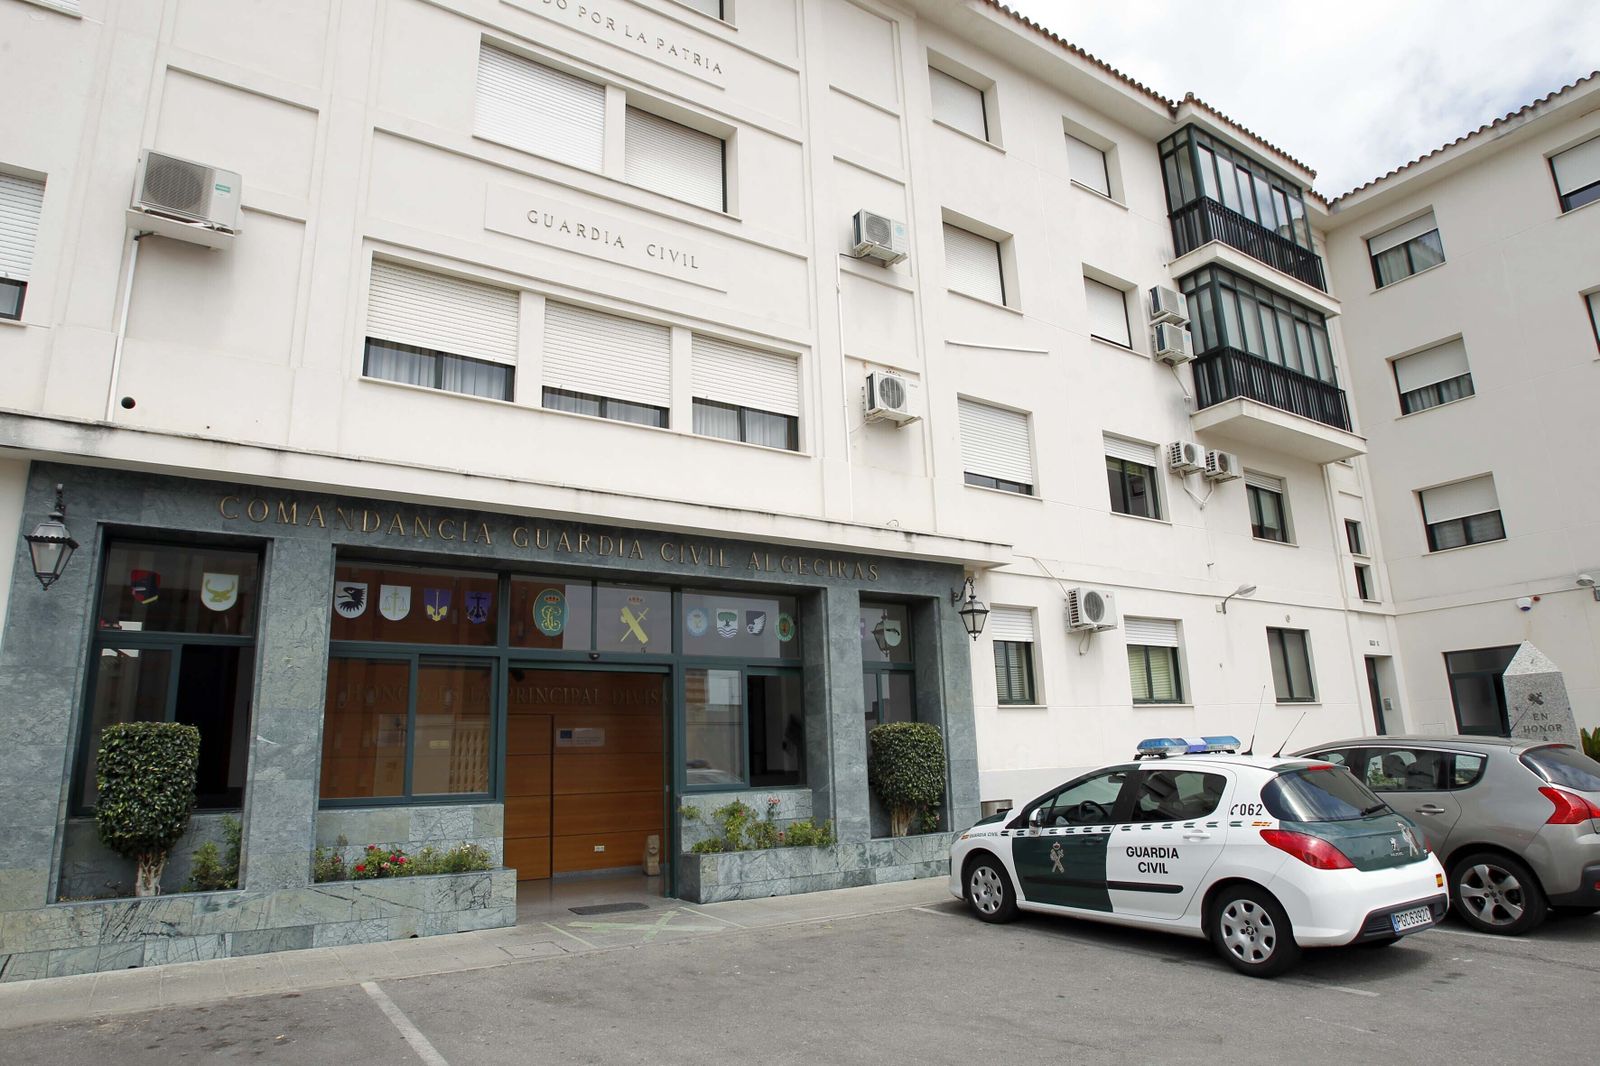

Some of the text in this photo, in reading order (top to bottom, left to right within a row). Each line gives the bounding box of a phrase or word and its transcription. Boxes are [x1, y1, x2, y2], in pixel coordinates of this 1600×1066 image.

[543, 0, 723, 75] O POR LA PATRIA
[526, 209, 699, 270] GUARDIA CIVIL
[219, 495, 880, 582] COMANDANCIA GUARDIA CIVIL ALGECIRAS
[1532, 712, 1549, 721] EN
[1522, 723, 1563, 734] HONOR
[1239, 803, 1263, 816] 062
[1126, 846, 1180, 859] GUARDIA
[1138, 861, 1169, 874] CIVIL
